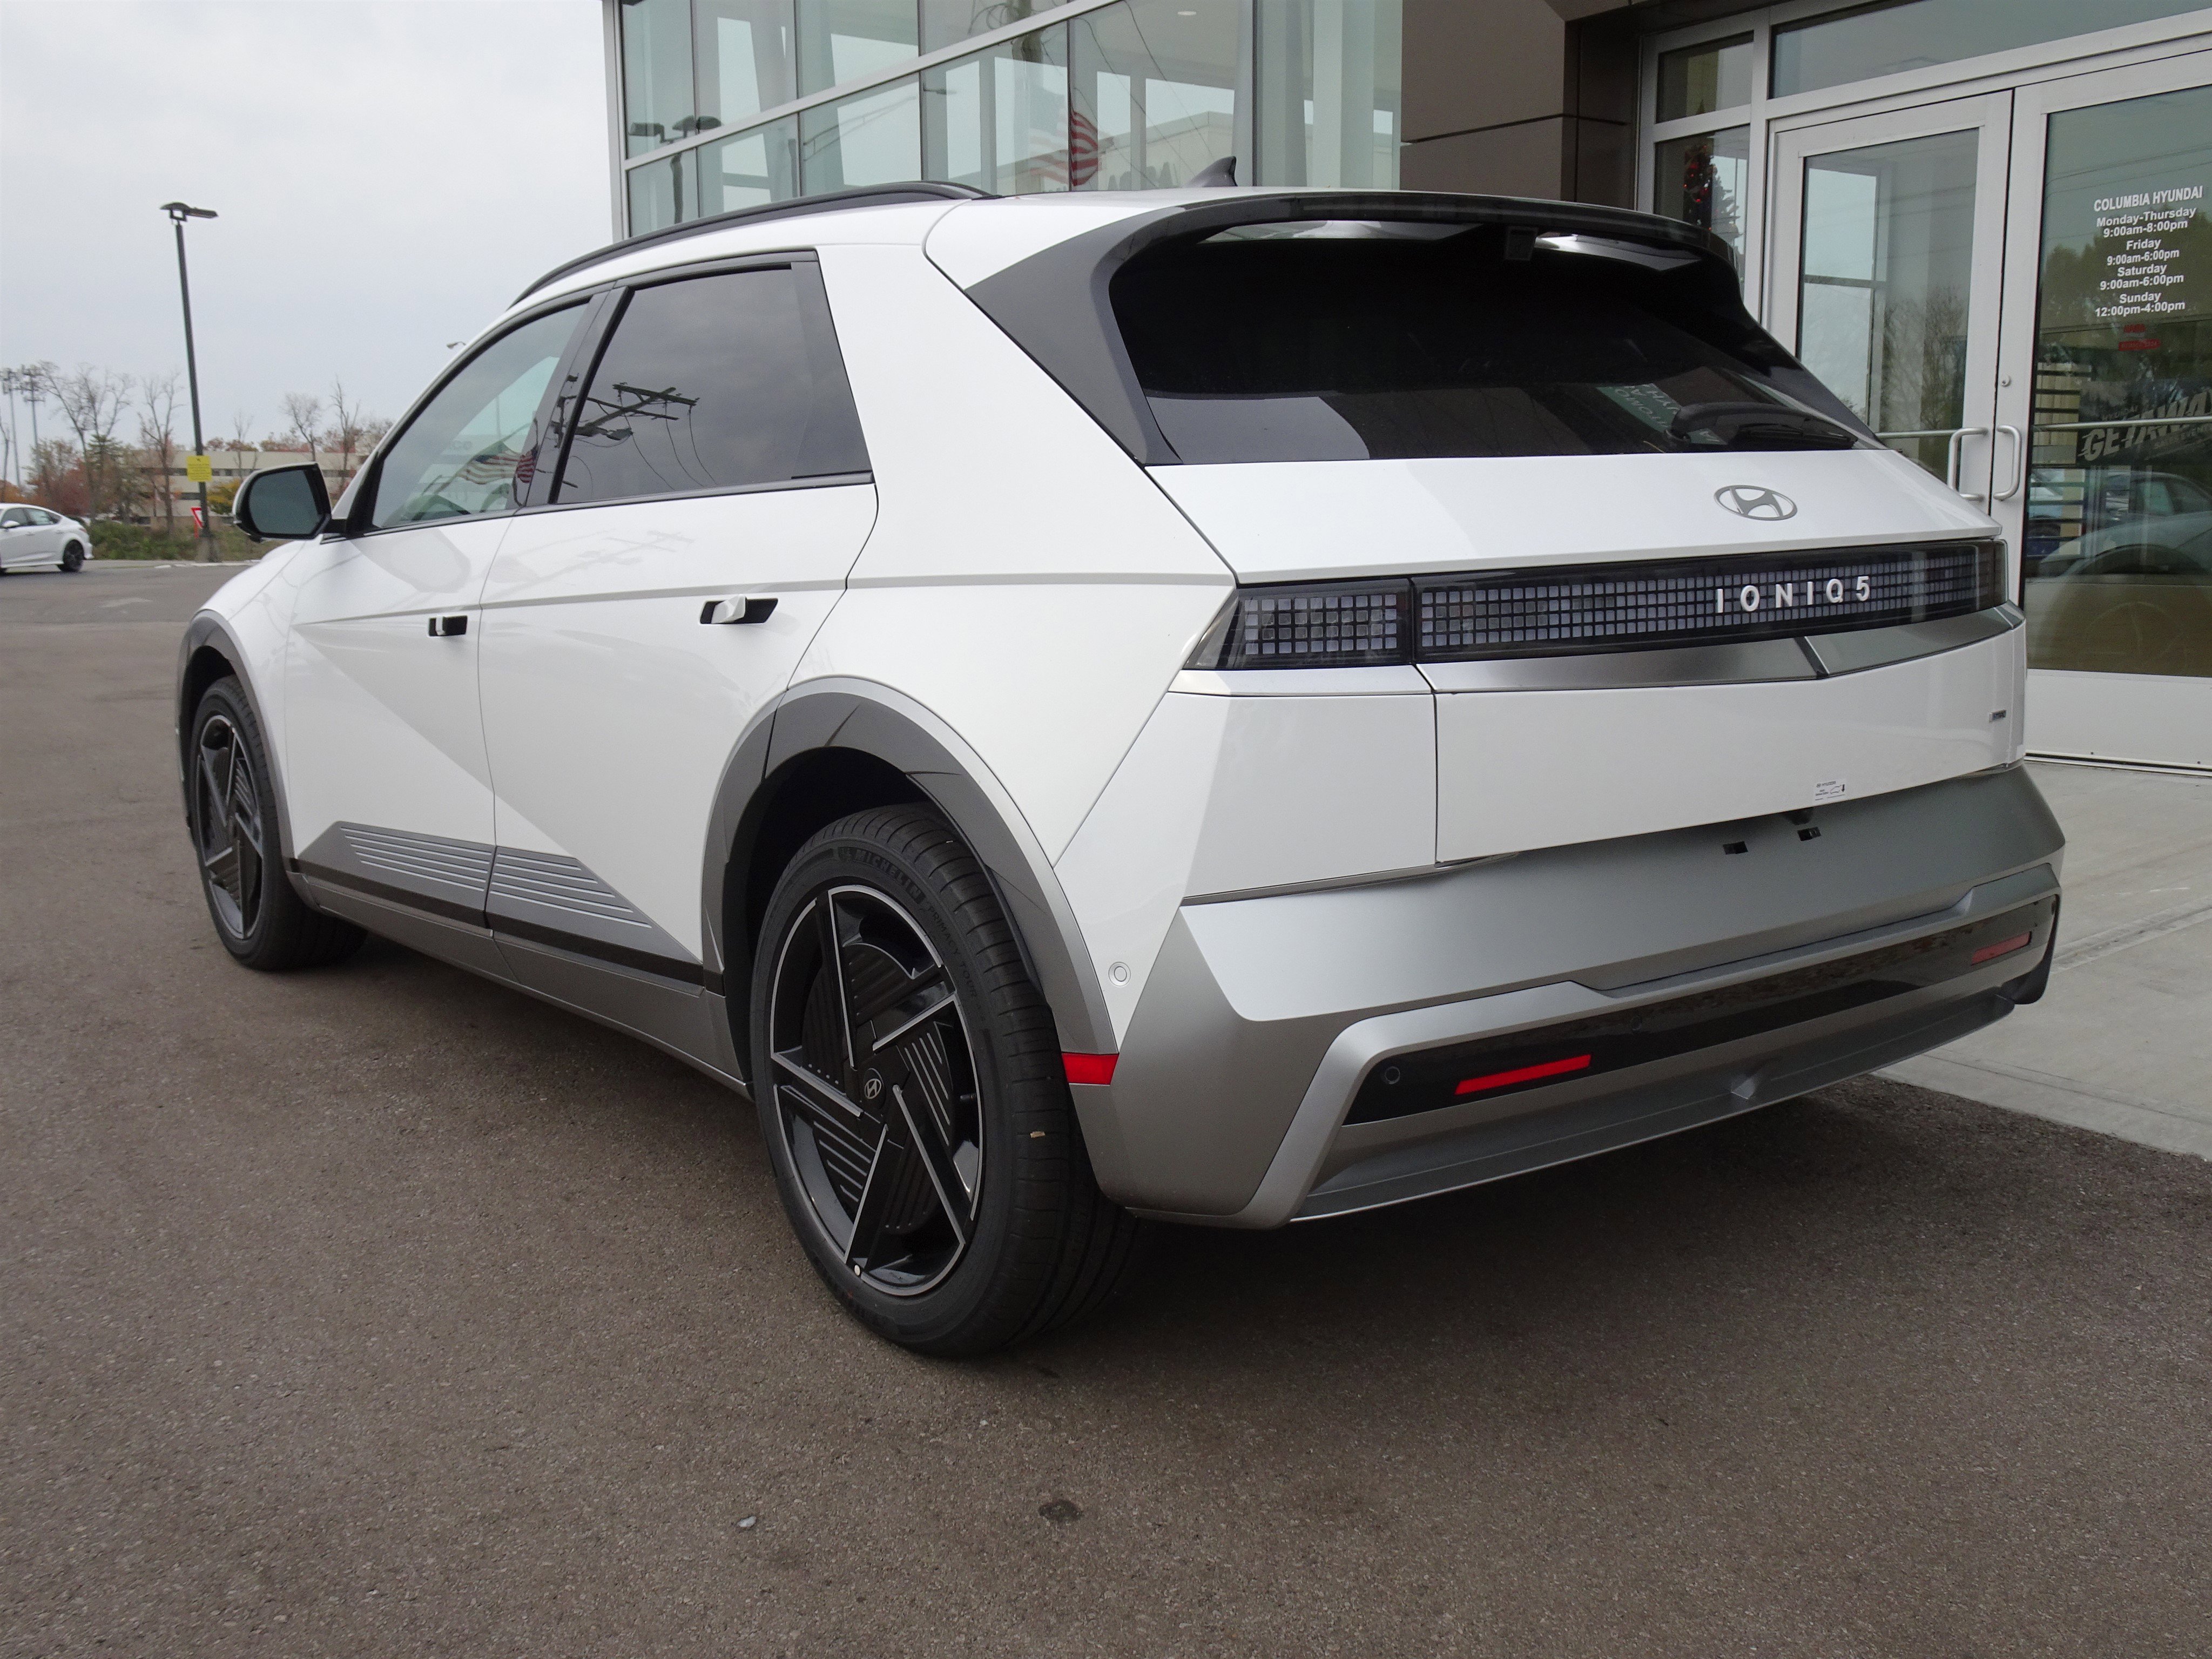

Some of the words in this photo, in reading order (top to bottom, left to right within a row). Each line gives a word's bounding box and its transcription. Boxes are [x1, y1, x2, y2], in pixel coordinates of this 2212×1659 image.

[2094, 193, 2150, 212] COLUMBIA
[2153, 186, 2203, 204] HYUNDAI
[2096, 207, 2196, 227] Monday-Thursday
[2103, 220, 2188, 238] 9:00am-8:00pm
[2126, 238, 2162, 250] Friday
[2107, 249, 2180, 266] 9:00am-6:00pm
[2117, 264, 2167, 277] Saturday
[2100, 274, 2184, 291] 9:00am-6:00pm
[2119, 292, 2162, 304] Sunday
[2095, 301, 2186, 317] 12:00pm-4:00pm
[2078, 391, 2212, 461] GETAWA
[1716, 578, 1843, 613] IONIQ
[1856, 576, 1870, 602] 5
[855, 848, 921, 898] MICHELIN
